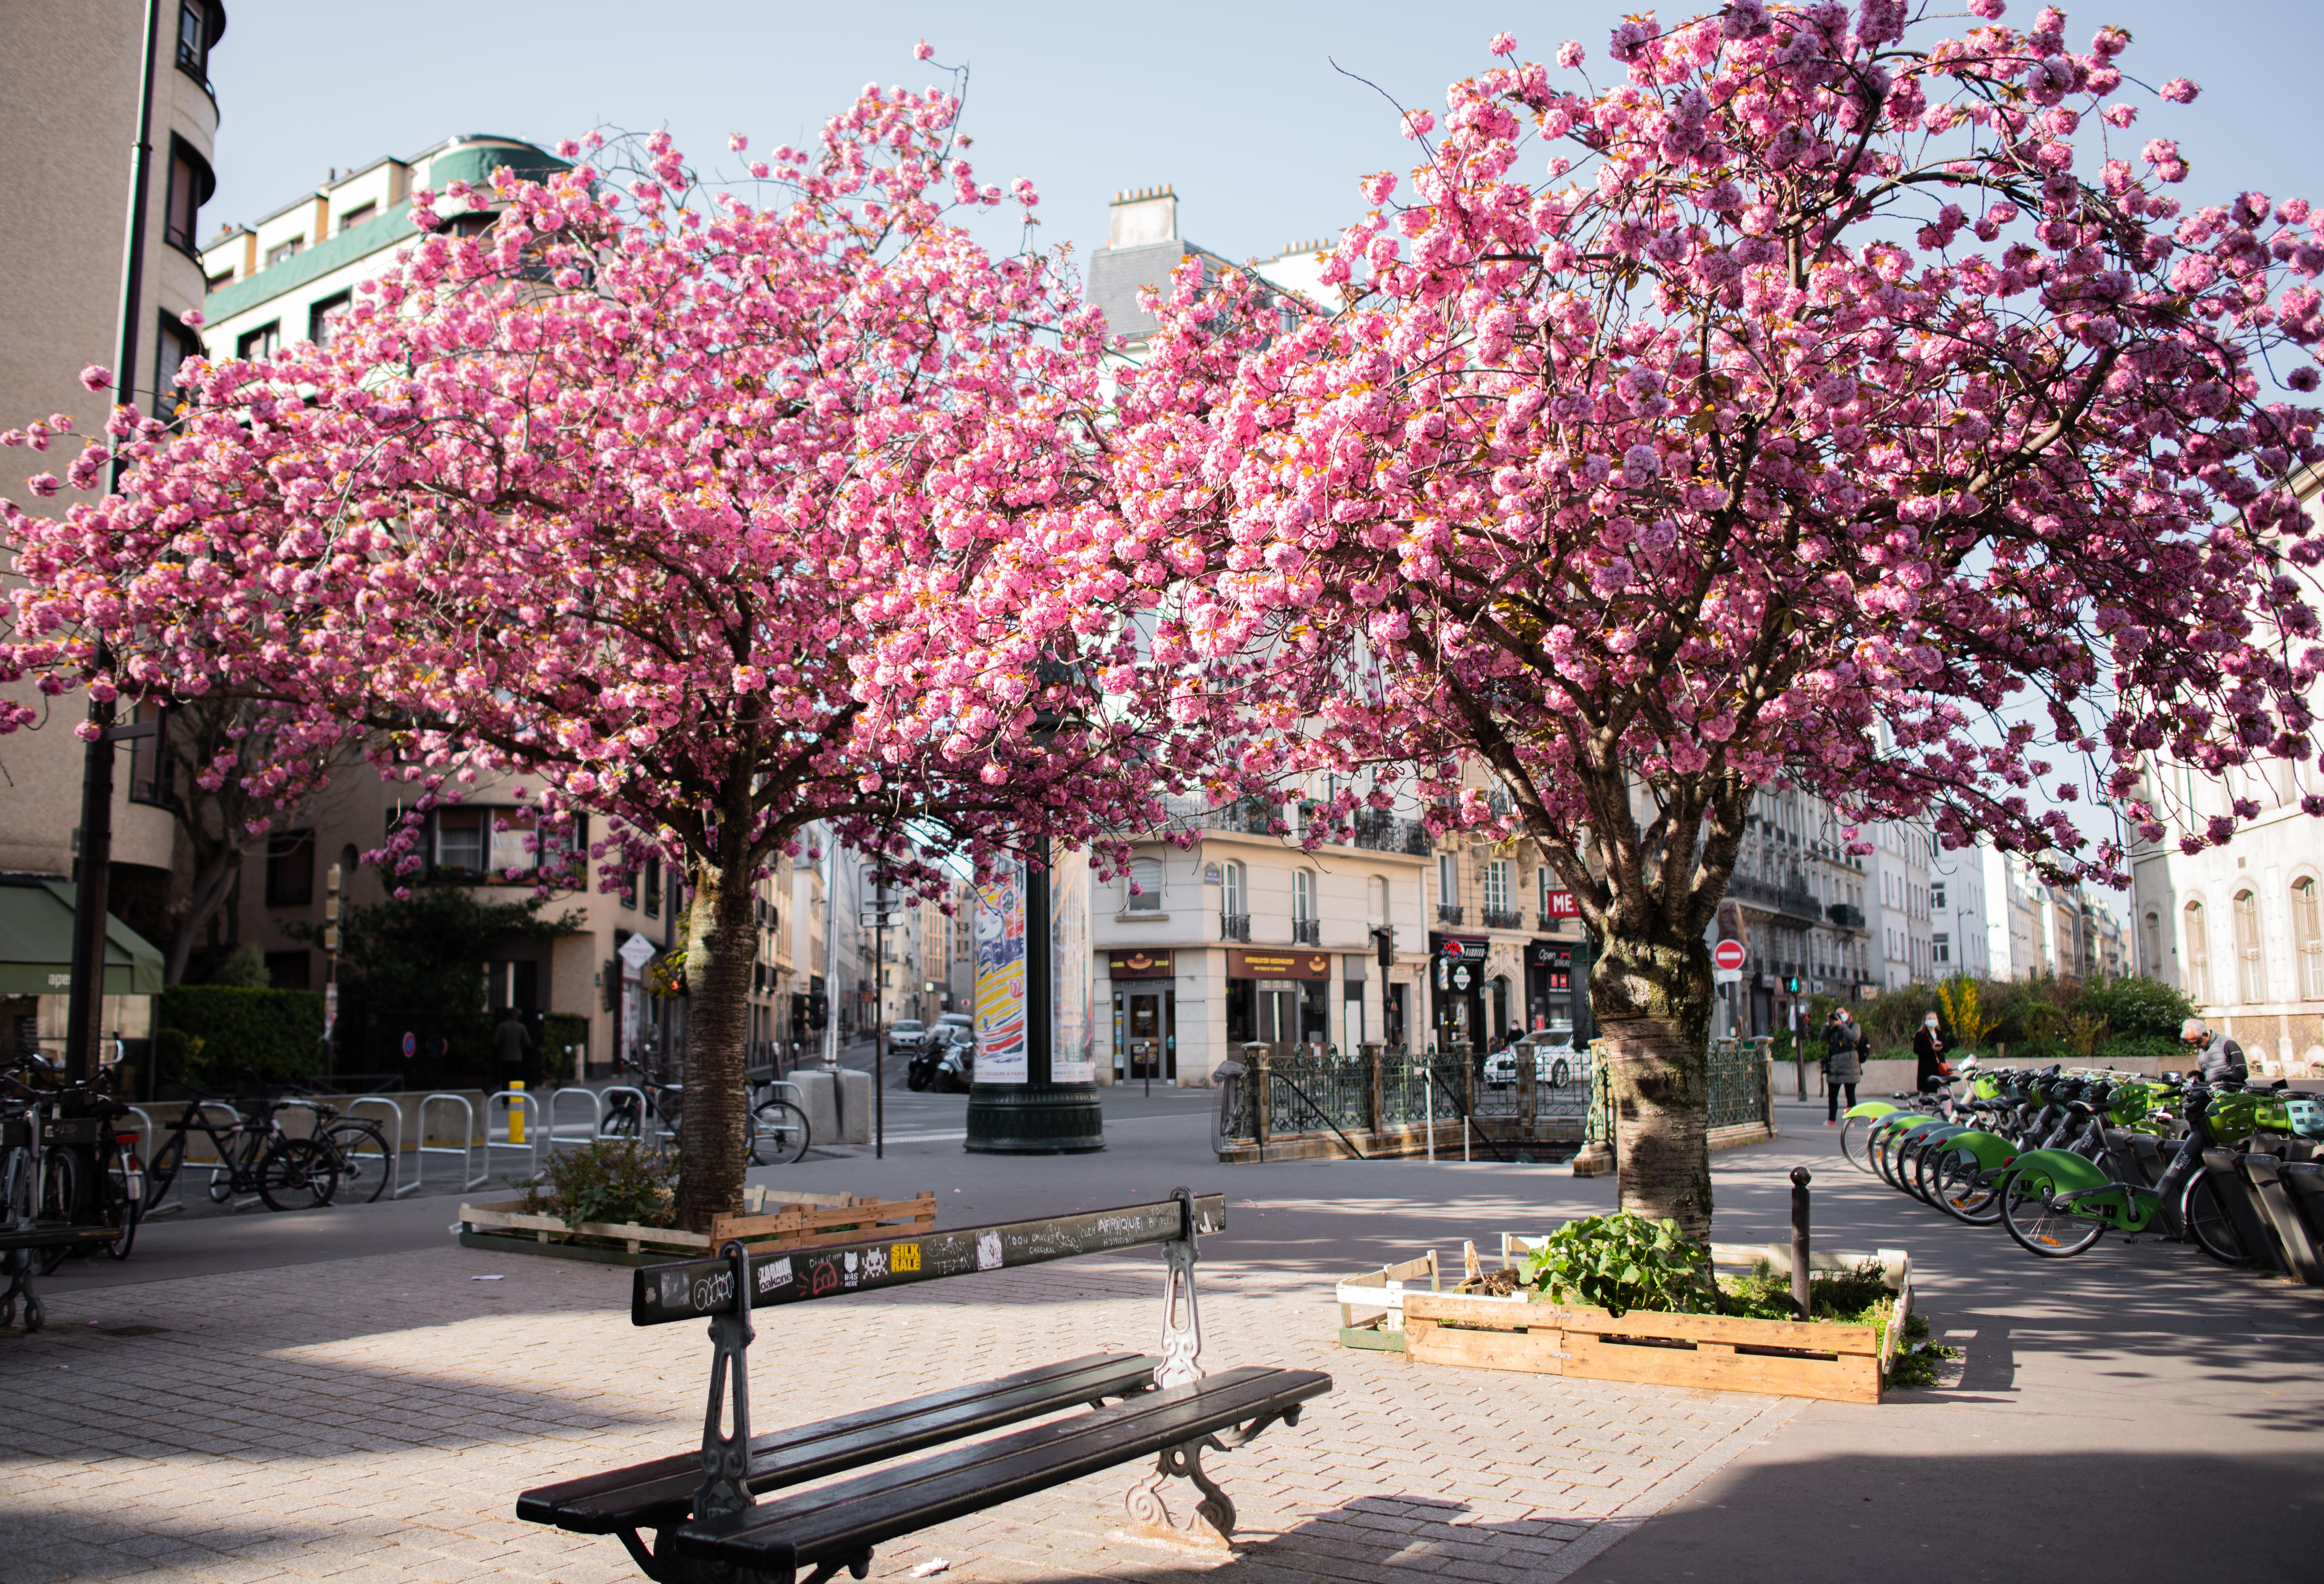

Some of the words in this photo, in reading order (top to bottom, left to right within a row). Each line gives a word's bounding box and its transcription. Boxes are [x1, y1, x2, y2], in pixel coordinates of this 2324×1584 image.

[1553, 893, 1579, 912] ME
[1465, 948, 1485, 957] BARBIER
[1539, 949, 1556, 962] Open
[892, 1246, 919, 1258] SILK
[892, 1258, 920, 1272] RALE
[760, 1273, 792, 1290] oakone
[844, 1273, 858, 1281] WAS
